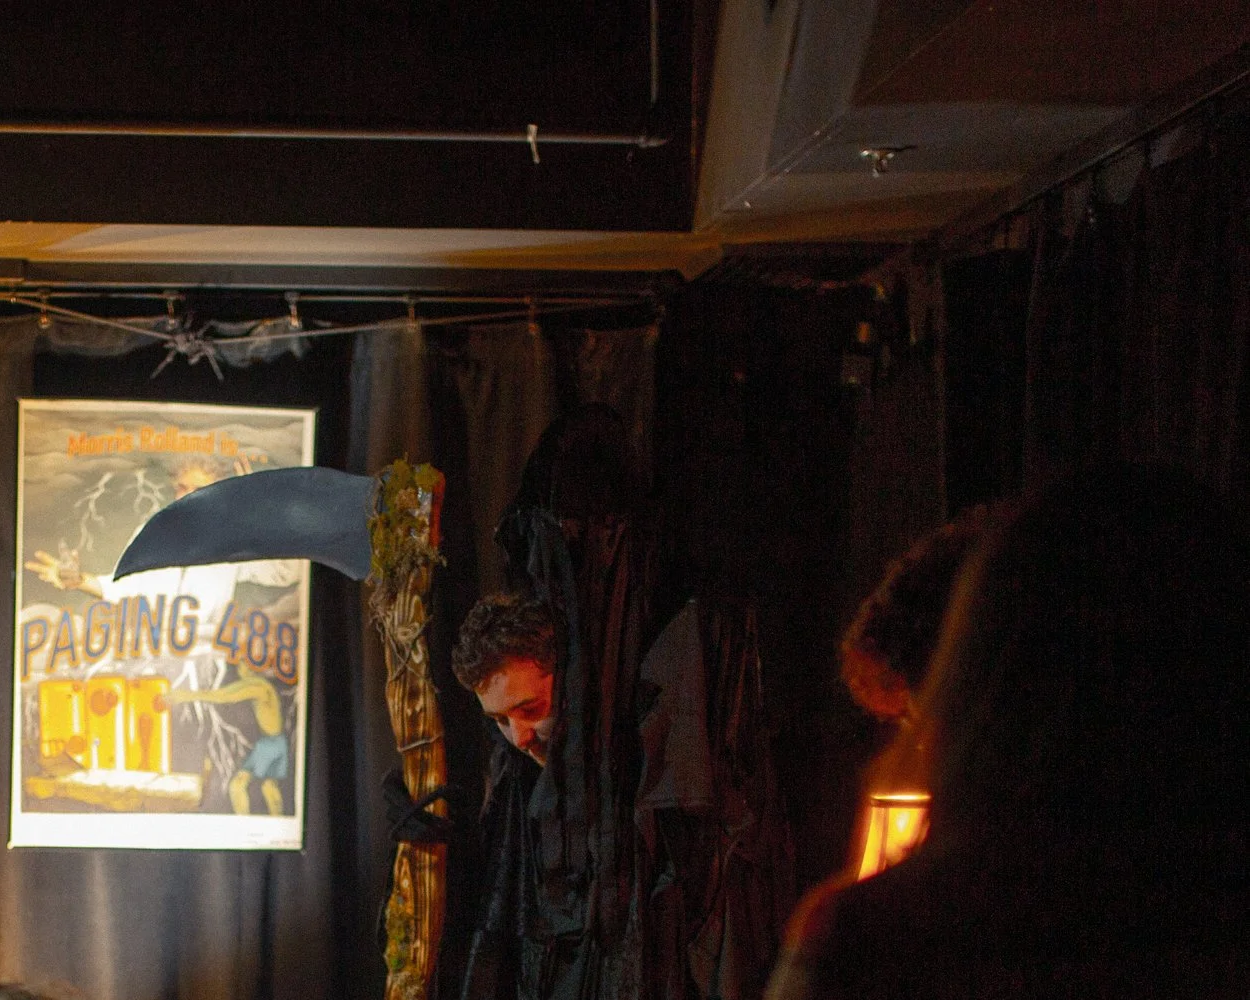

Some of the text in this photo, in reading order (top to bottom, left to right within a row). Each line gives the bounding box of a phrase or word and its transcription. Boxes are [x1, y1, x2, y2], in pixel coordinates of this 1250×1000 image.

[67, 428, 134, 457] Morris
[140, 426, 215, 455] Rolland
[21, 594, 299, 685] PAGING 488
